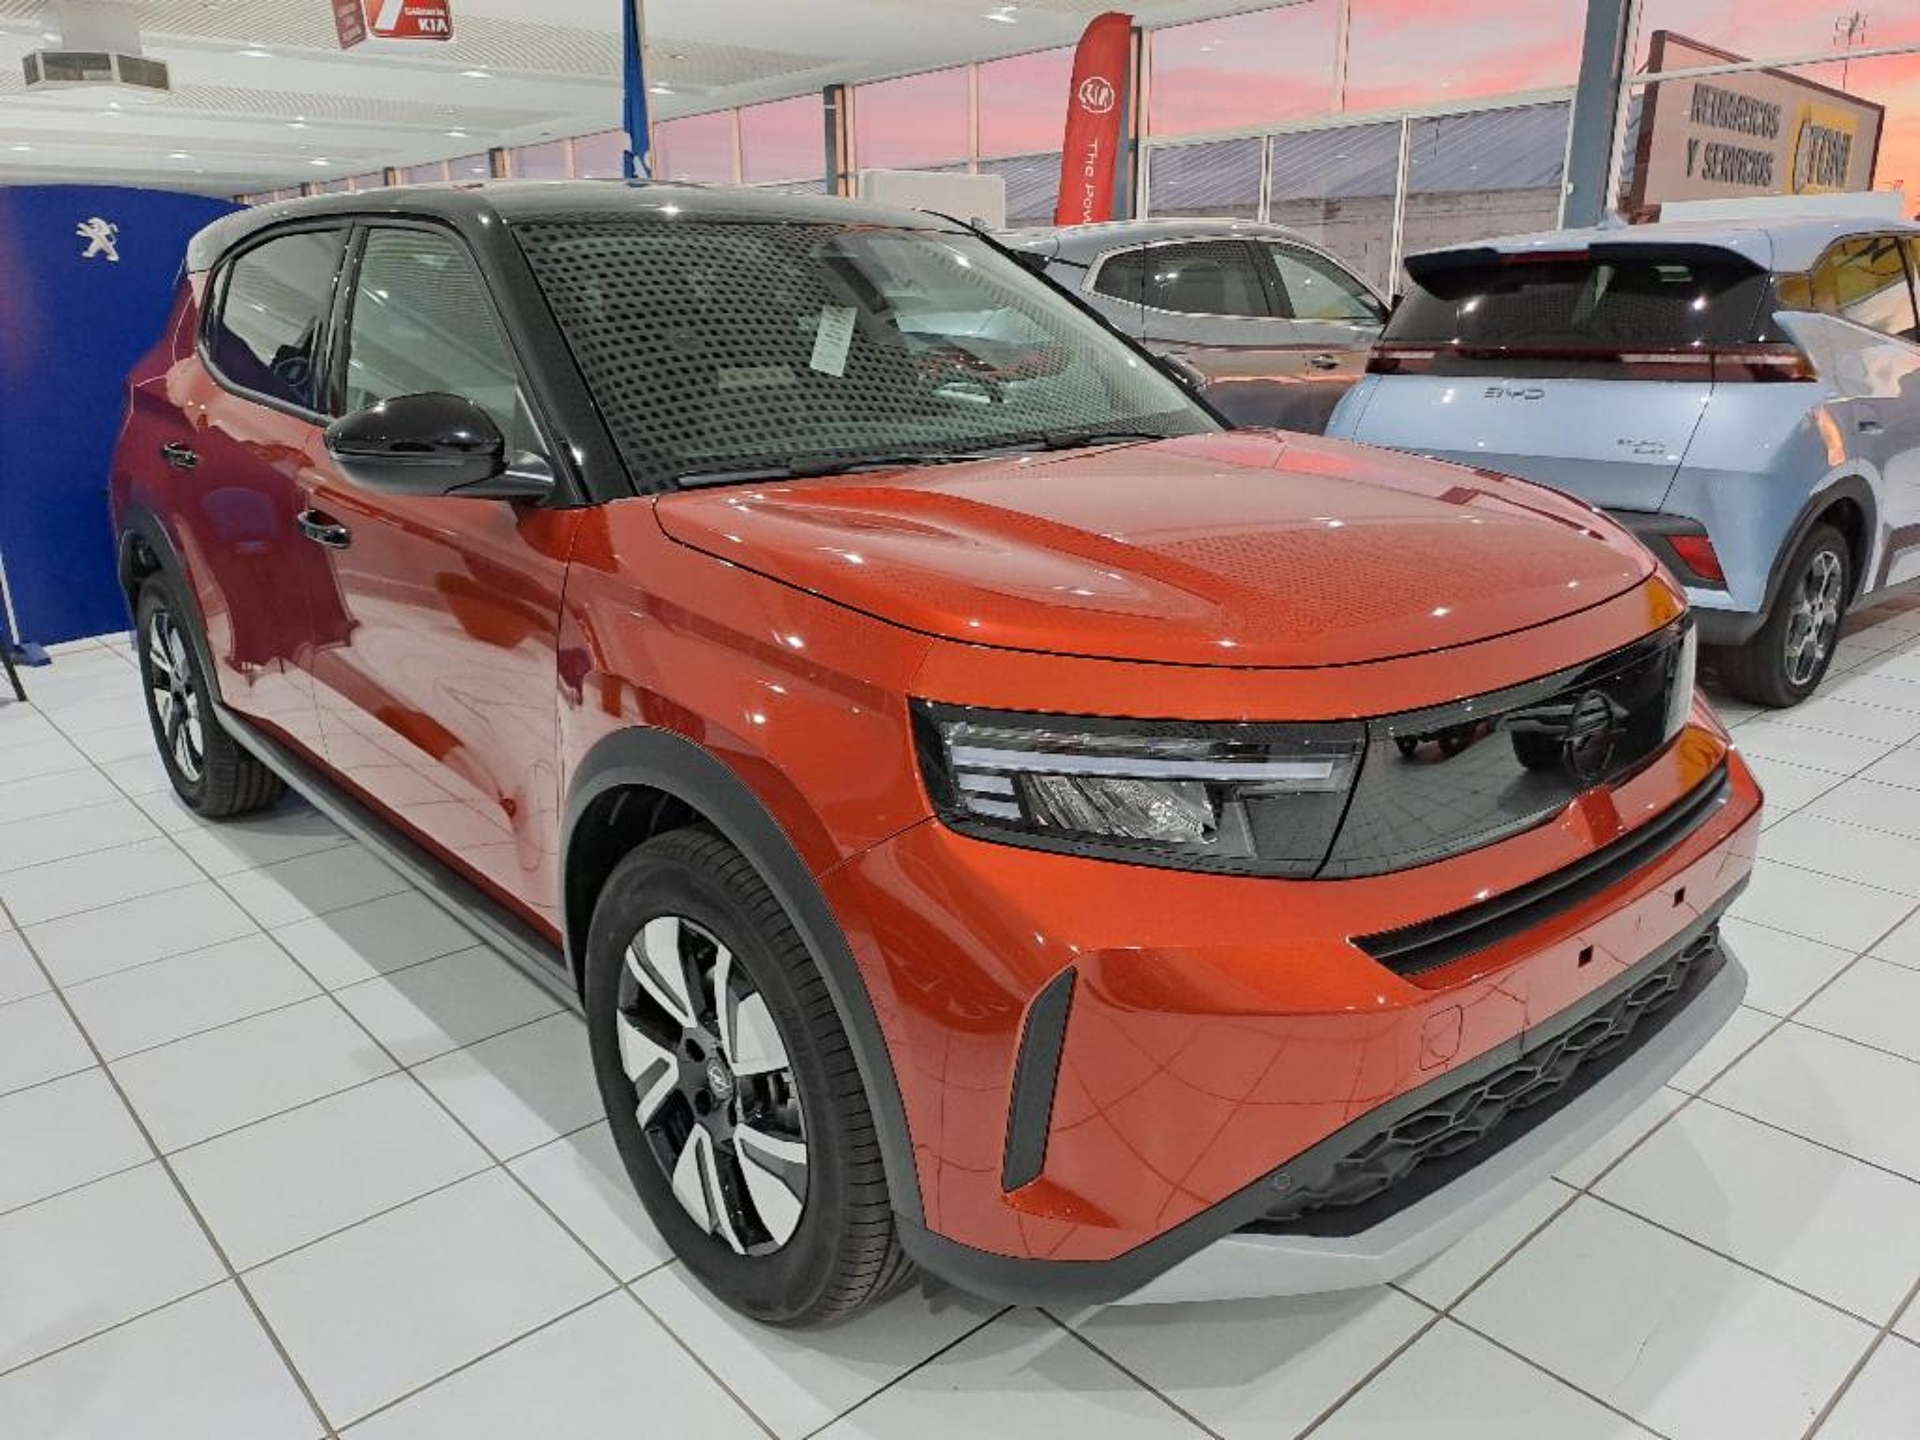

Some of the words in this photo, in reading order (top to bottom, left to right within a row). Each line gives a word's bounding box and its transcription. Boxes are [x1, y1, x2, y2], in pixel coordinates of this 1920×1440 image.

[418, 18, 448, 32] KIA
[1084, 138, 1098, 178] The
[1687, 136, 1700, 178] Y
[1702, 142, 1774, 187] SERVICIOS
[1484, 387, 1545, 400] BYD
